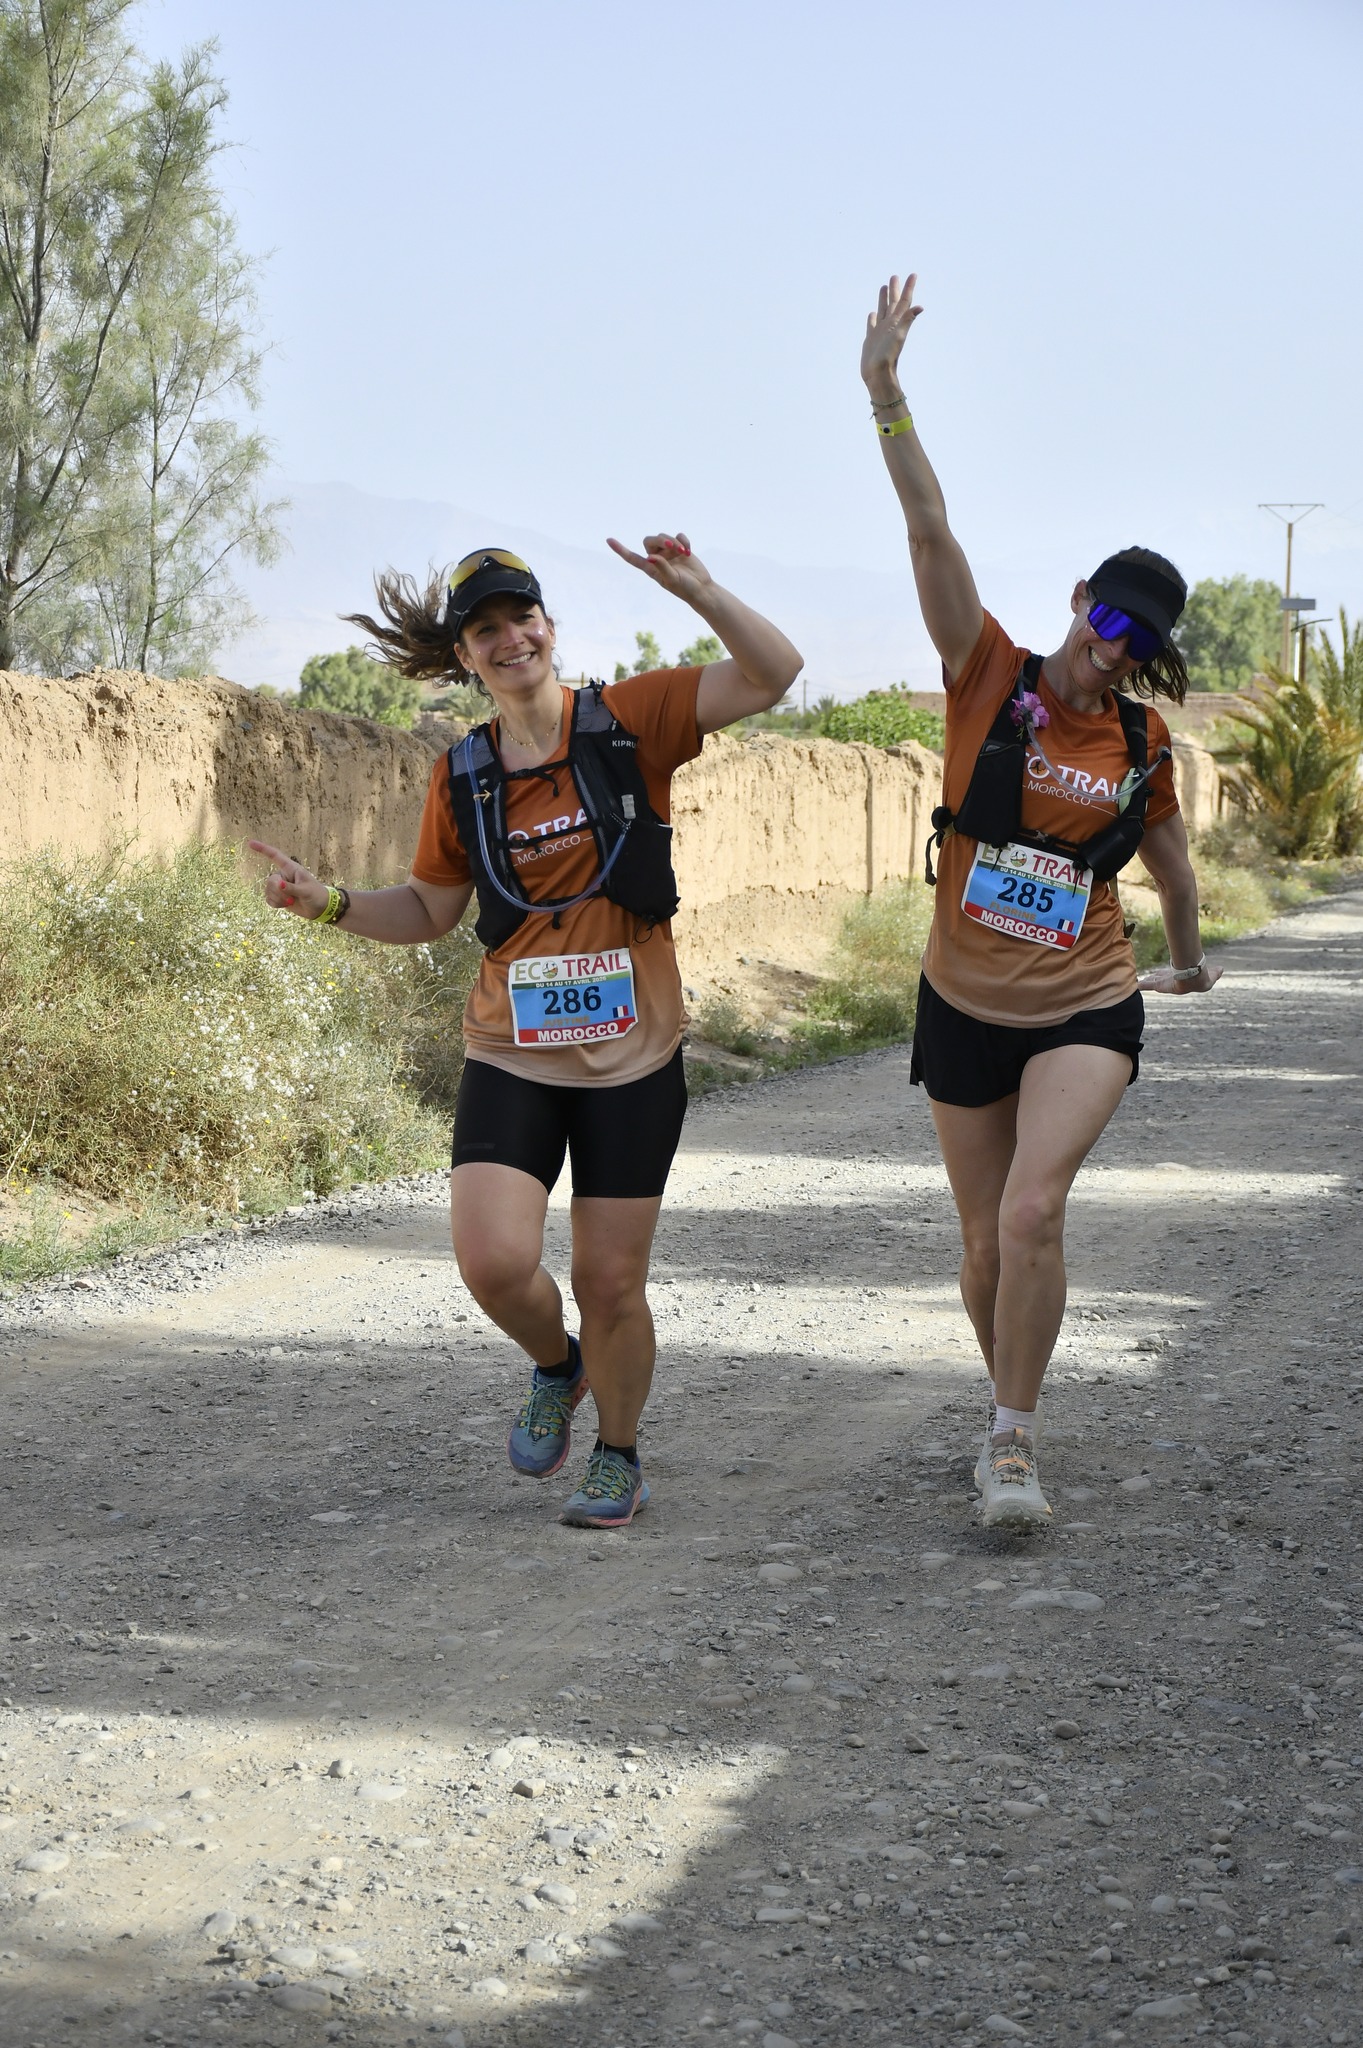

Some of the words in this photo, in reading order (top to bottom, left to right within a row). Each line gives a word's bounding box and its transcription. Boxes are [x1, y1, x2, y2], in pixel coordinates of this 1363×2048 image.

[1027, 780, 1091, 806] MOROCCO
[516, 834, 581, 865] MOROCCO
[1032, 854, 1088, 888] TRAIL
[1035, 876, 1052, 886] AVRIL
[997, 877, 1056, 913] 285
[989, 901, 1037, 922] FLORINE
[980, 909, 1058, 943] MOROCCO
[562, 953, 628, 978] TRAIL
[543, 985, 602, 1015] 286
[537, 1022, 619, 1042] MOROCCO
